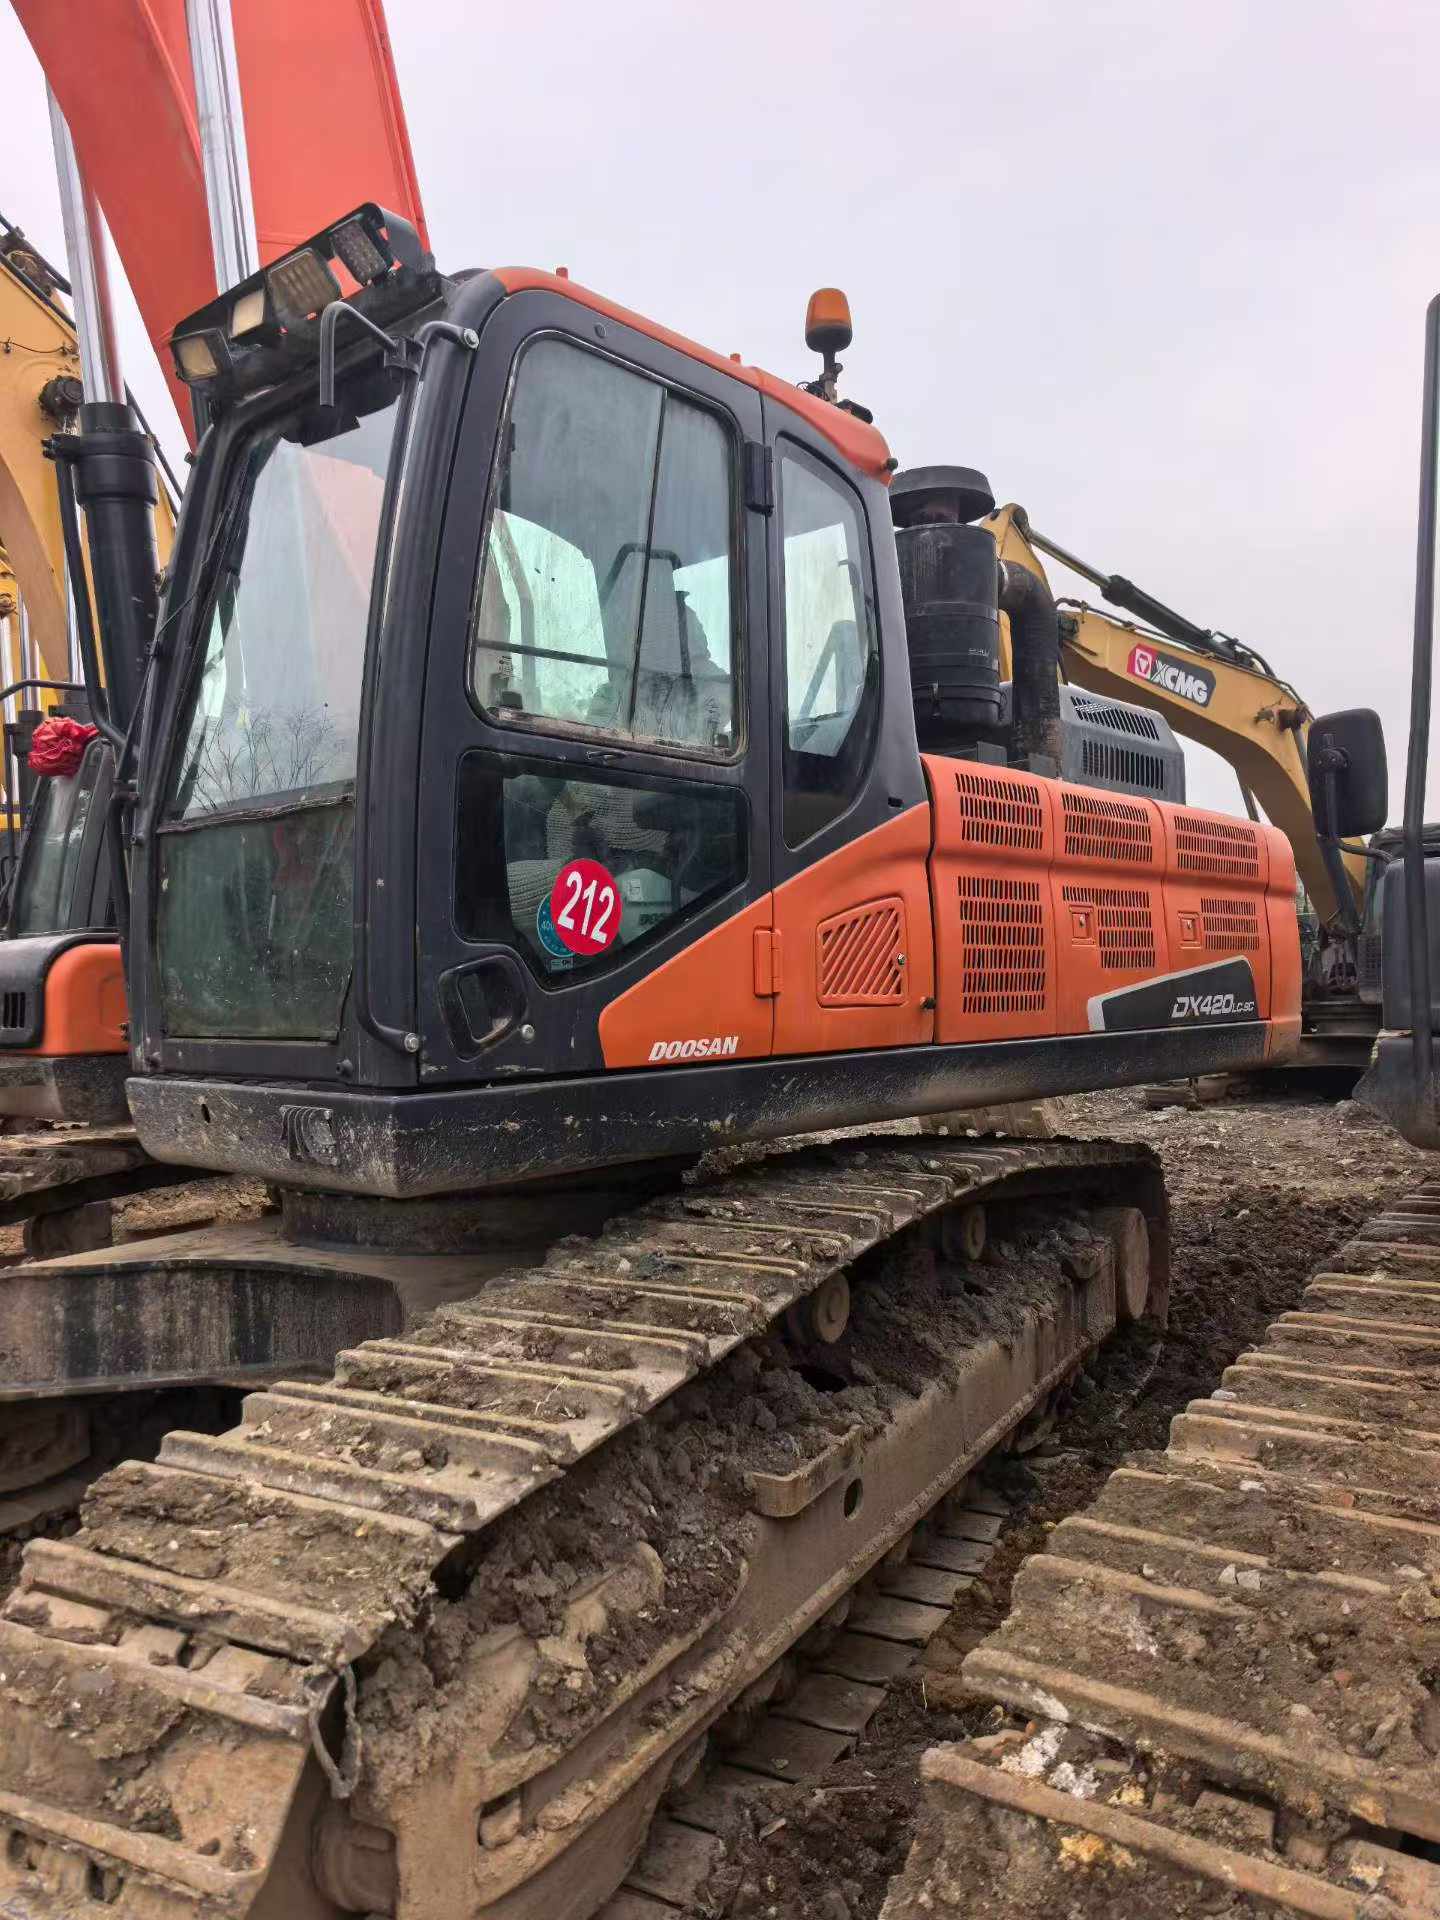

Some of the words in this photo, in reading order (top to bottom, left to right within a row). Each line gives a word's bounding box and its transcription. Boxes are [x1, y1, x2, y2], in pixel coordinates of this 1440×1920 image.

[1151, 660, 1208, 704] XCMG
[557, 871, 615, 944] 212
[648, 1036, 739, 1061] DOOSAN
